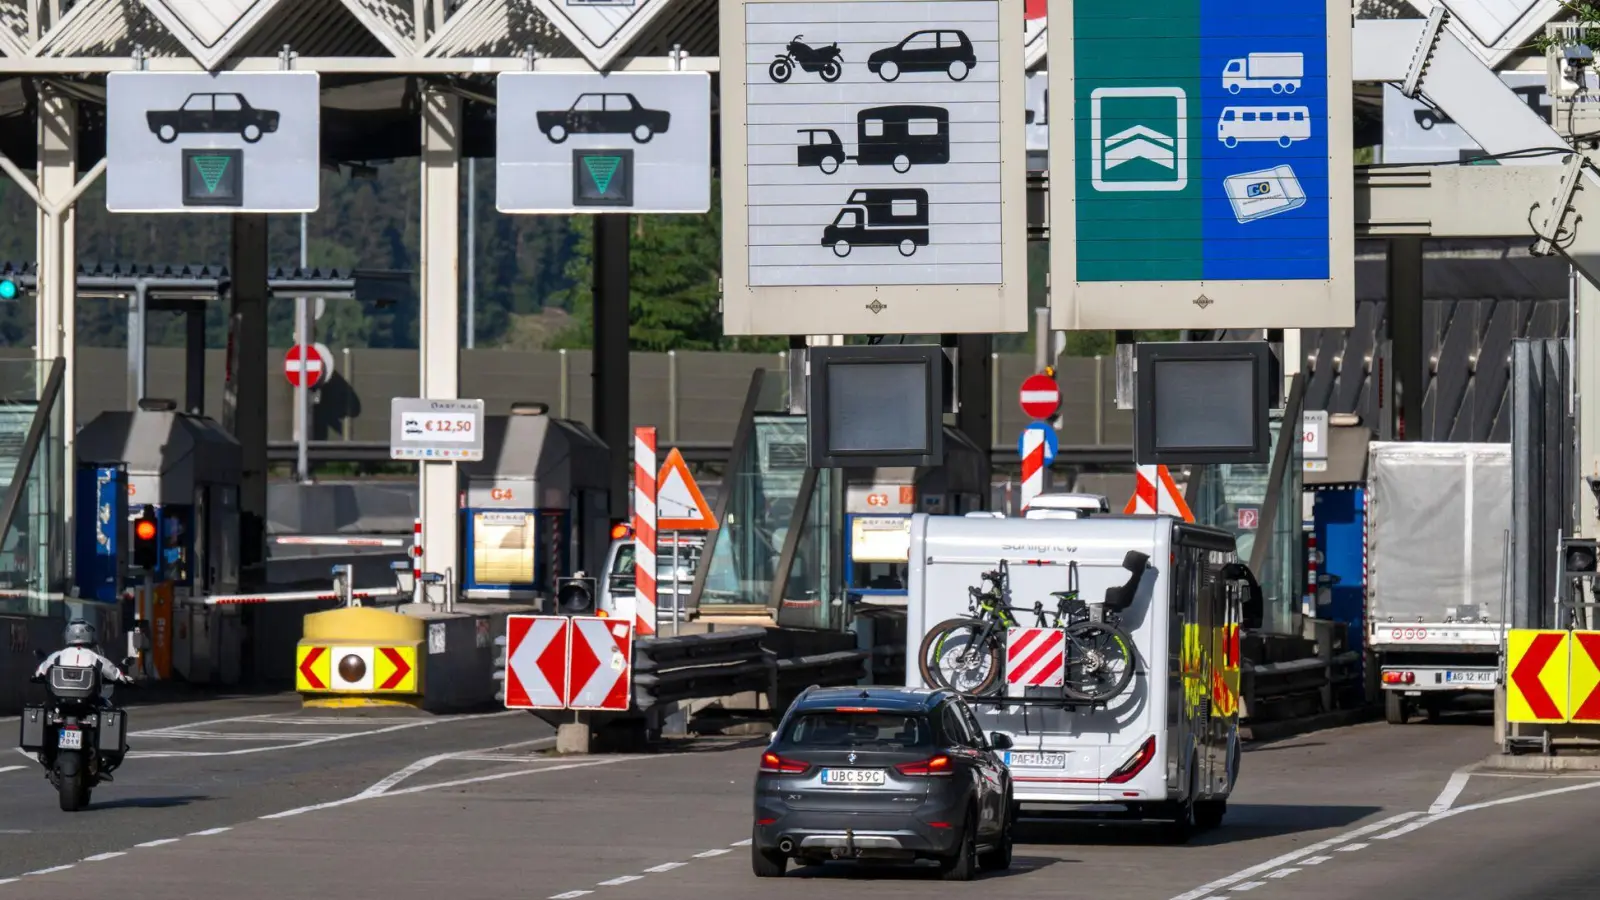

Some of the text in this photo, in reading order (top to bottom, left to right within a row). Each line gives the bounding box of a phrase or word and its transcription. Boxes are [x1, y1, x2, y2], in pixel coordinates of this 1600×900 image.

[1248, 182, 1270, 197] GO
[425, 420, 471, 433] € 12,50
[491, 488, 513, 500] G4
[867, 493, 889, 506] G3
[1011, 754, 1029, 764] PAF
[1044, 755, 1064, 765] 379
[831, 771, 879, 782] UBC 59C
